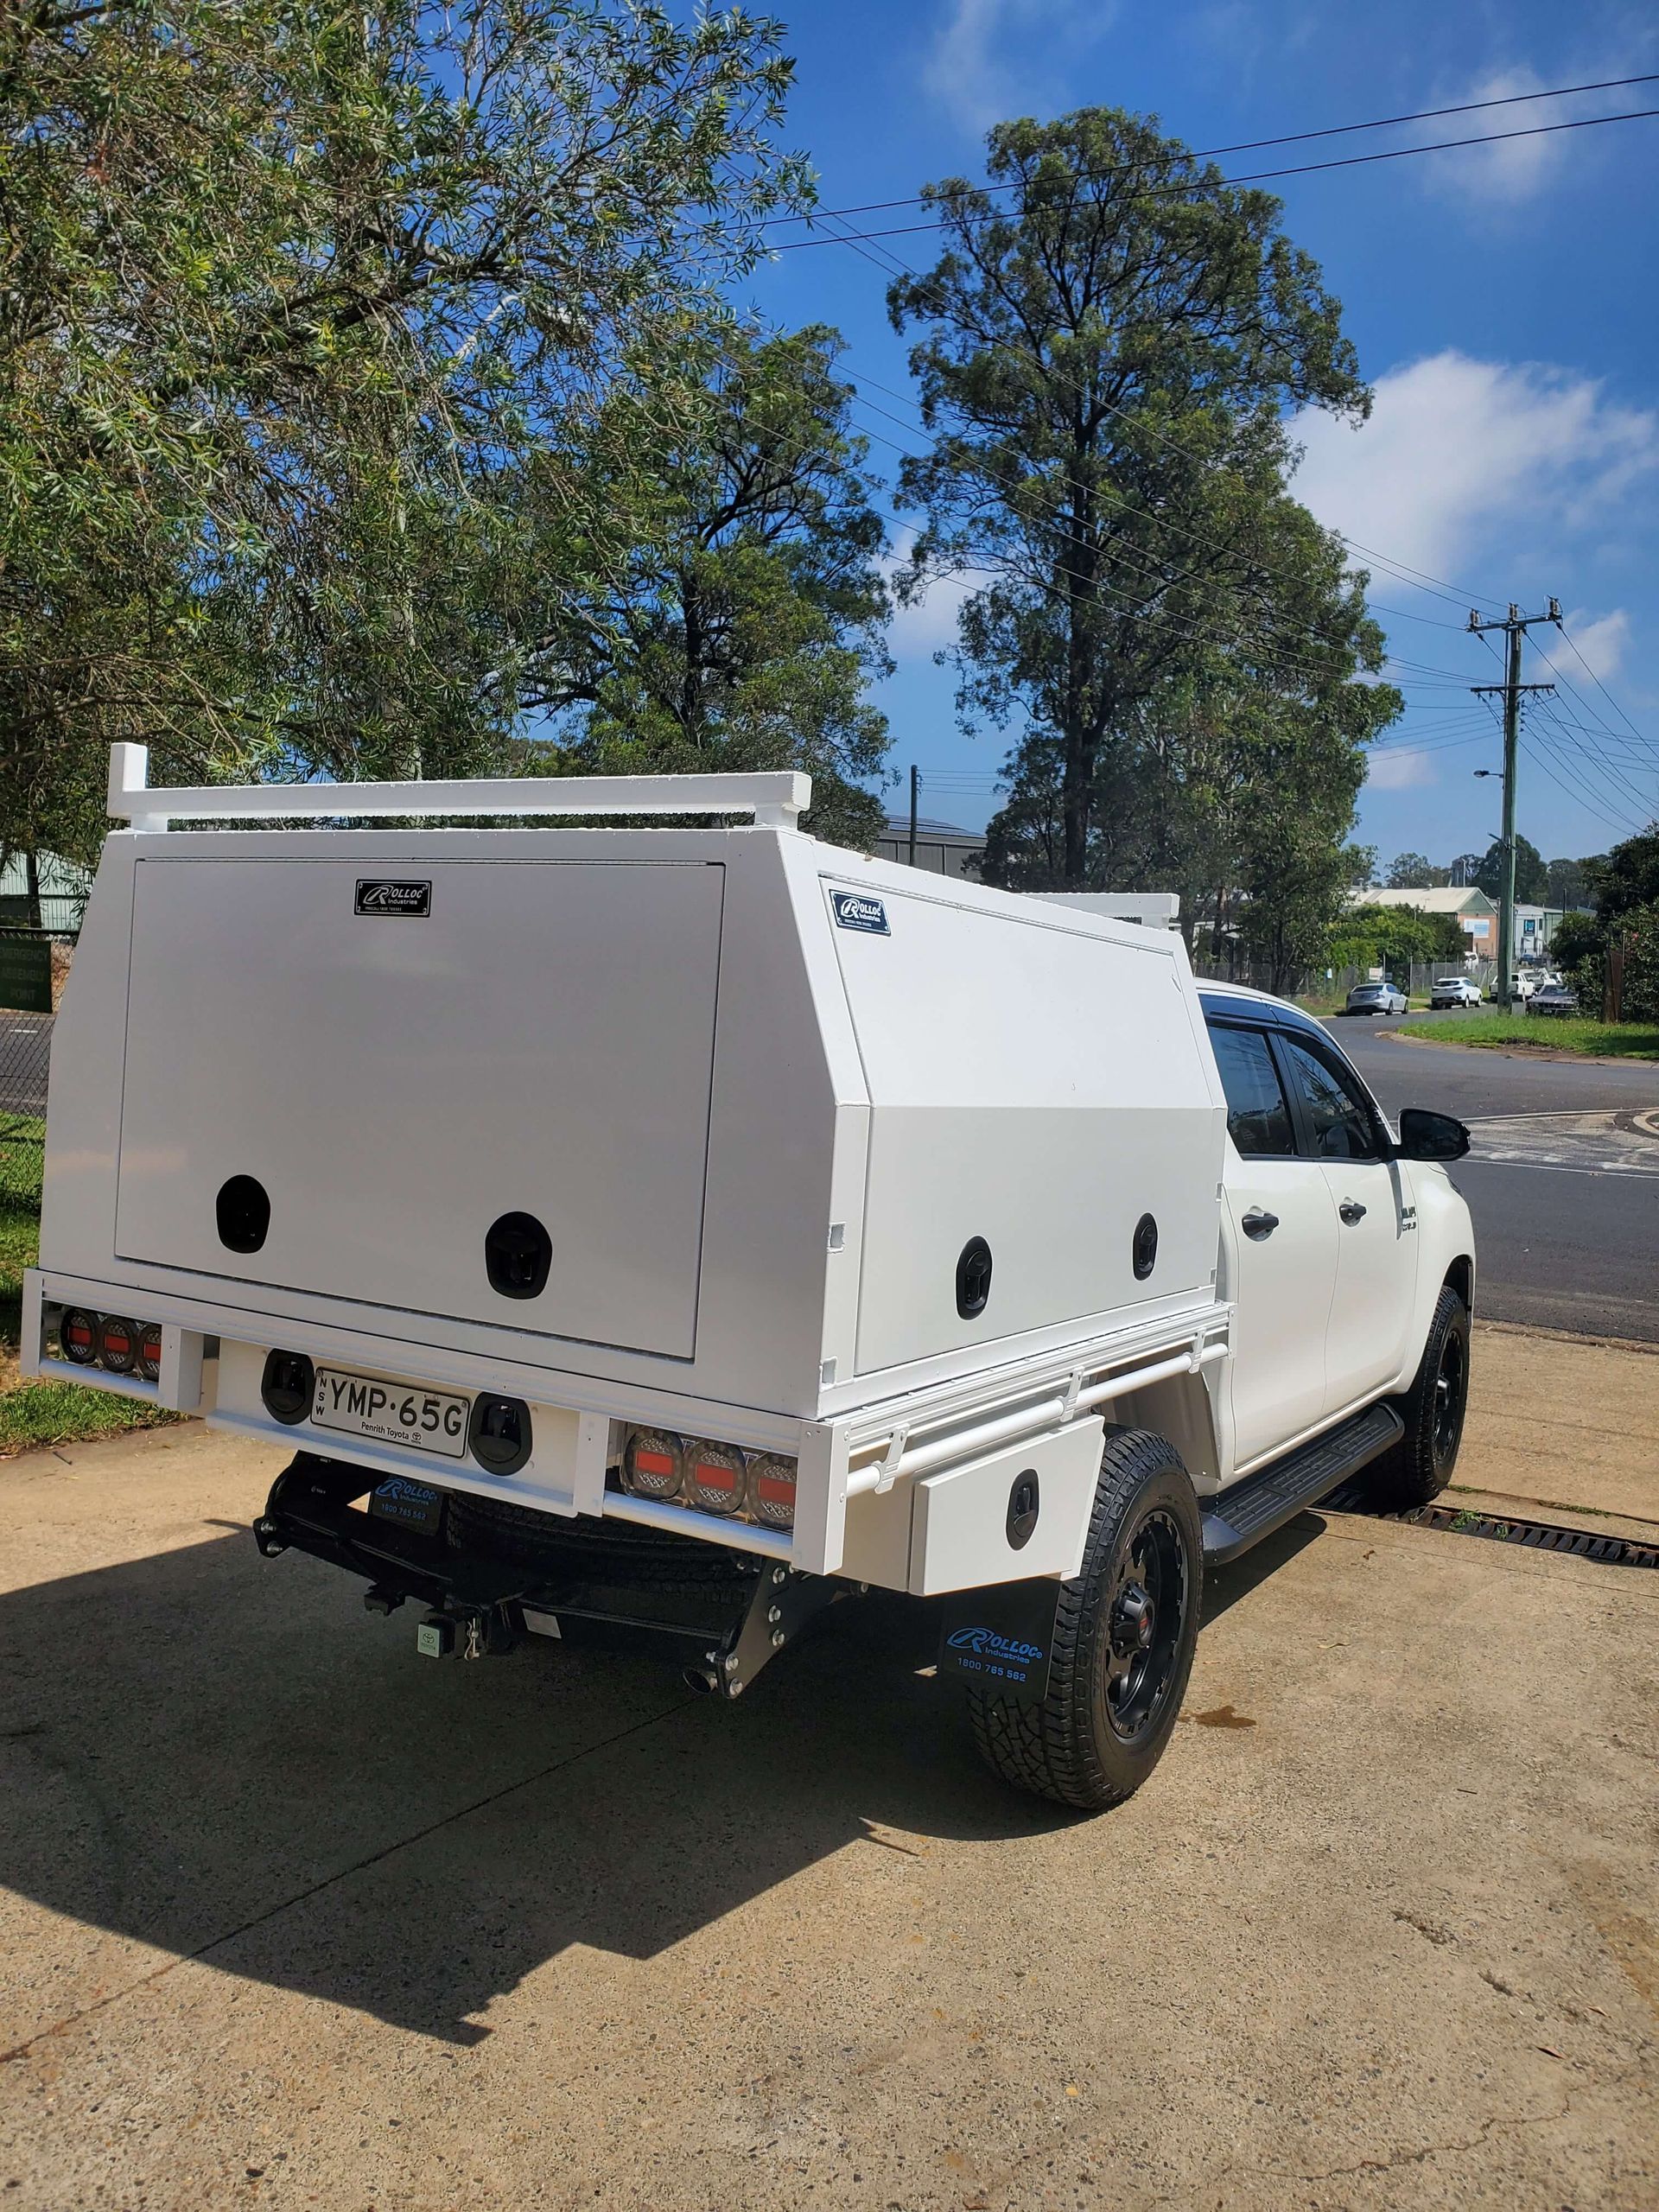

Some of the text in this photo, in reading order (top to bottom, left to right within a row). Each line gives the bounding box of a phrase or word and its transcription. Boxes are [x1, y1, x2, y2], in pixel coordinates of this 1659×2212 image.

[10, 988, 36, 1002] POINT
[361, 1421, 410, 1440] Penrith Toyota
[382, 1503, 397, 1513] 1800
[985, 1647, 1030, 1664] Industries
[957, 1657, 1027, 1682] 1800 765 562
